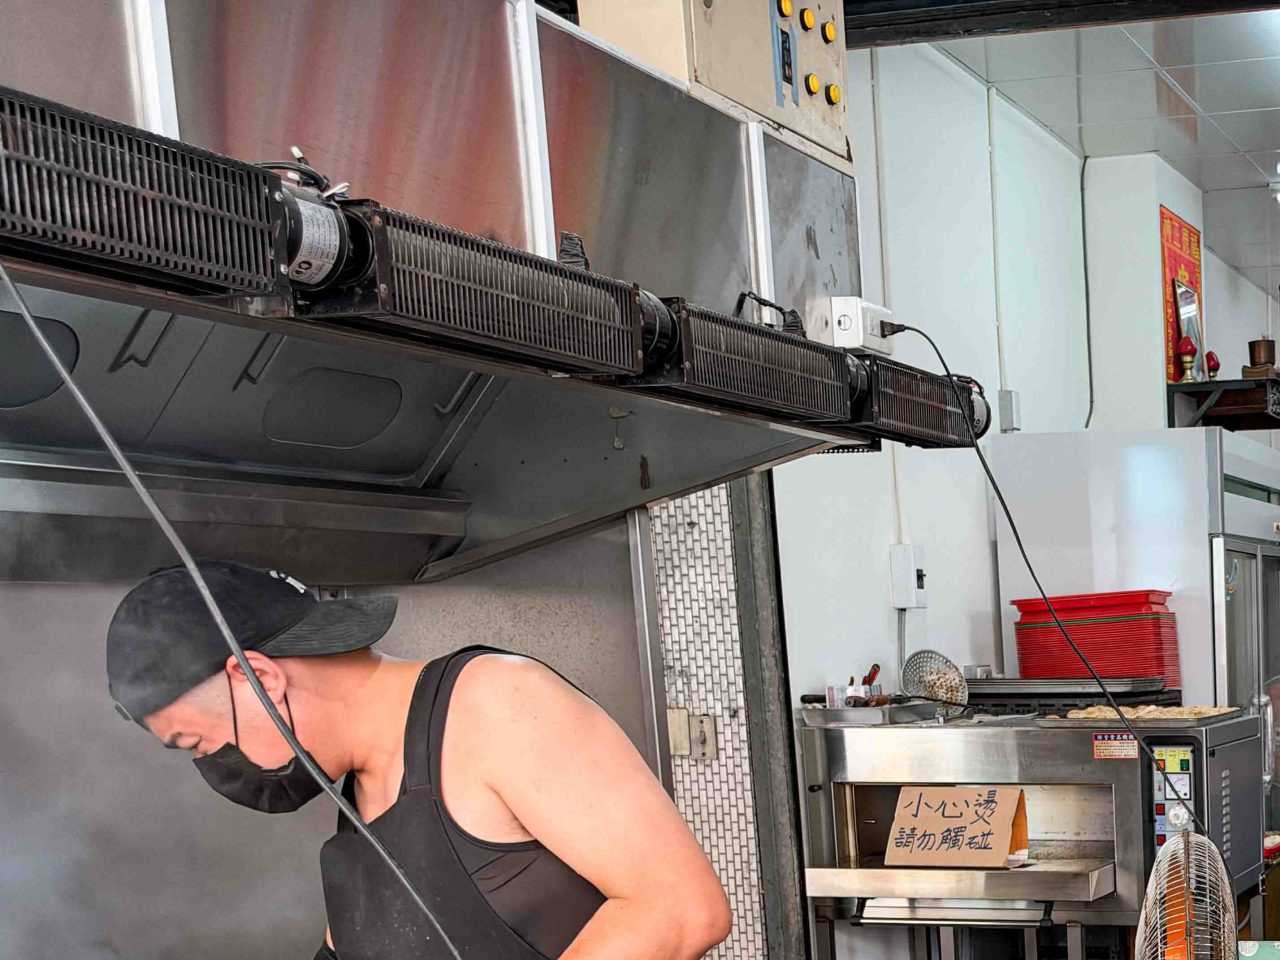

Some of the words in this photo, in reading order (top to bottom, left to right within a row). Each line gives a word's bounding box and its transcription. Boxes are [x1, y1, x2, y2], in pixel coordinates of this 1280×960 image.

[904, 790, 998, 825] 小心燙
[895, 826, 994, 853] 請勿觸碰
